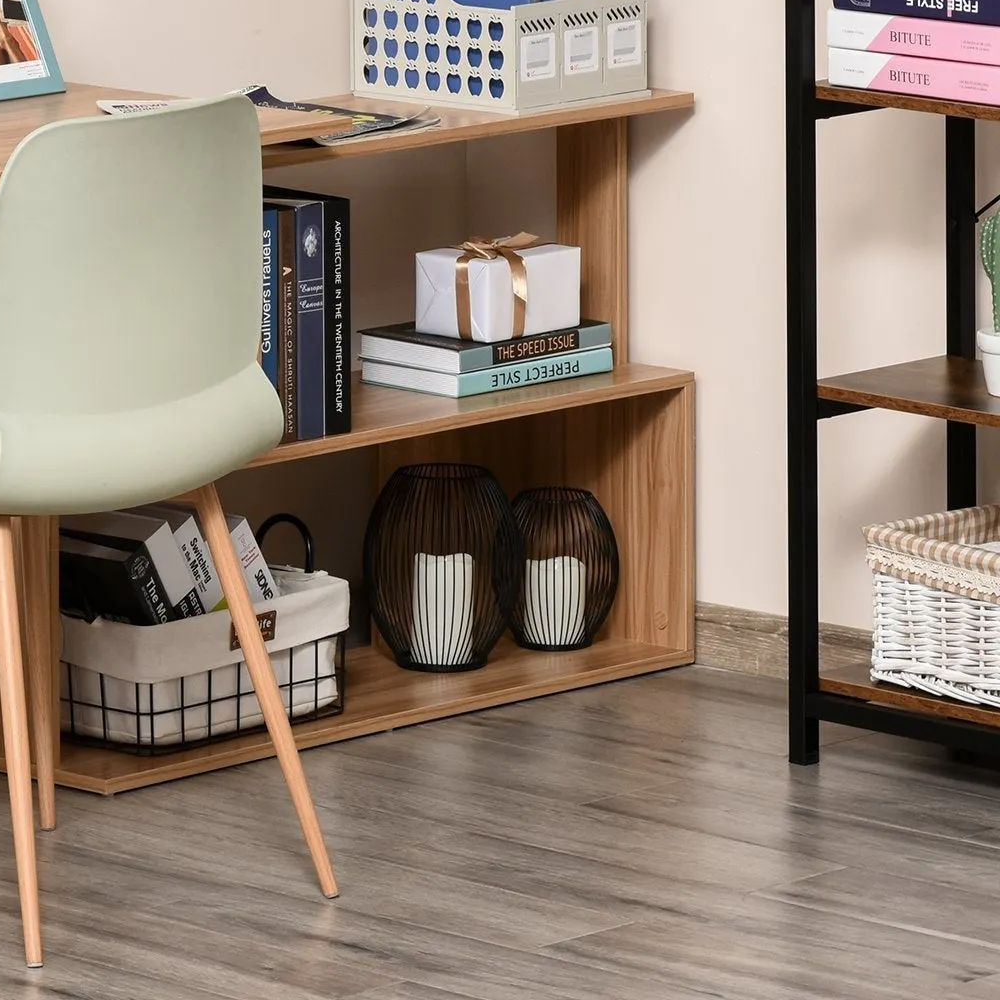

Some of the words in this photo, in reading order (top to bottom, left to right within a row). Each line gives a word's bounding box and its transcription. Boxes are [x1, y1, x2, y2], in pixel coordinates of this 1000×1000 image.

[889, 30, 932, 47] BITUTE
[889, 70, 931, 86] BITUTE
[334, 220, 342, 284] ARCHITECTURE
[335, 288, 342, 299] IN
[287, 340, 293, 353] OF
[335, 322, 343, 371] TWENTIETH
[497, 344, 516, 361] THE
[517, 338, 546, 356] SPEED
[547, 333, 576, 351] ISSUE
[491, 370, 521, 388] SYLE
[525, 359, 581, 381] PERFECT
[335, 372, 343, 413] CENTURY
[181, 543, 187, 552] to
[189, 558, 201, 581] Mac
[190, 537, 212, 584] Switching
[146, 576, 159, 603] The
